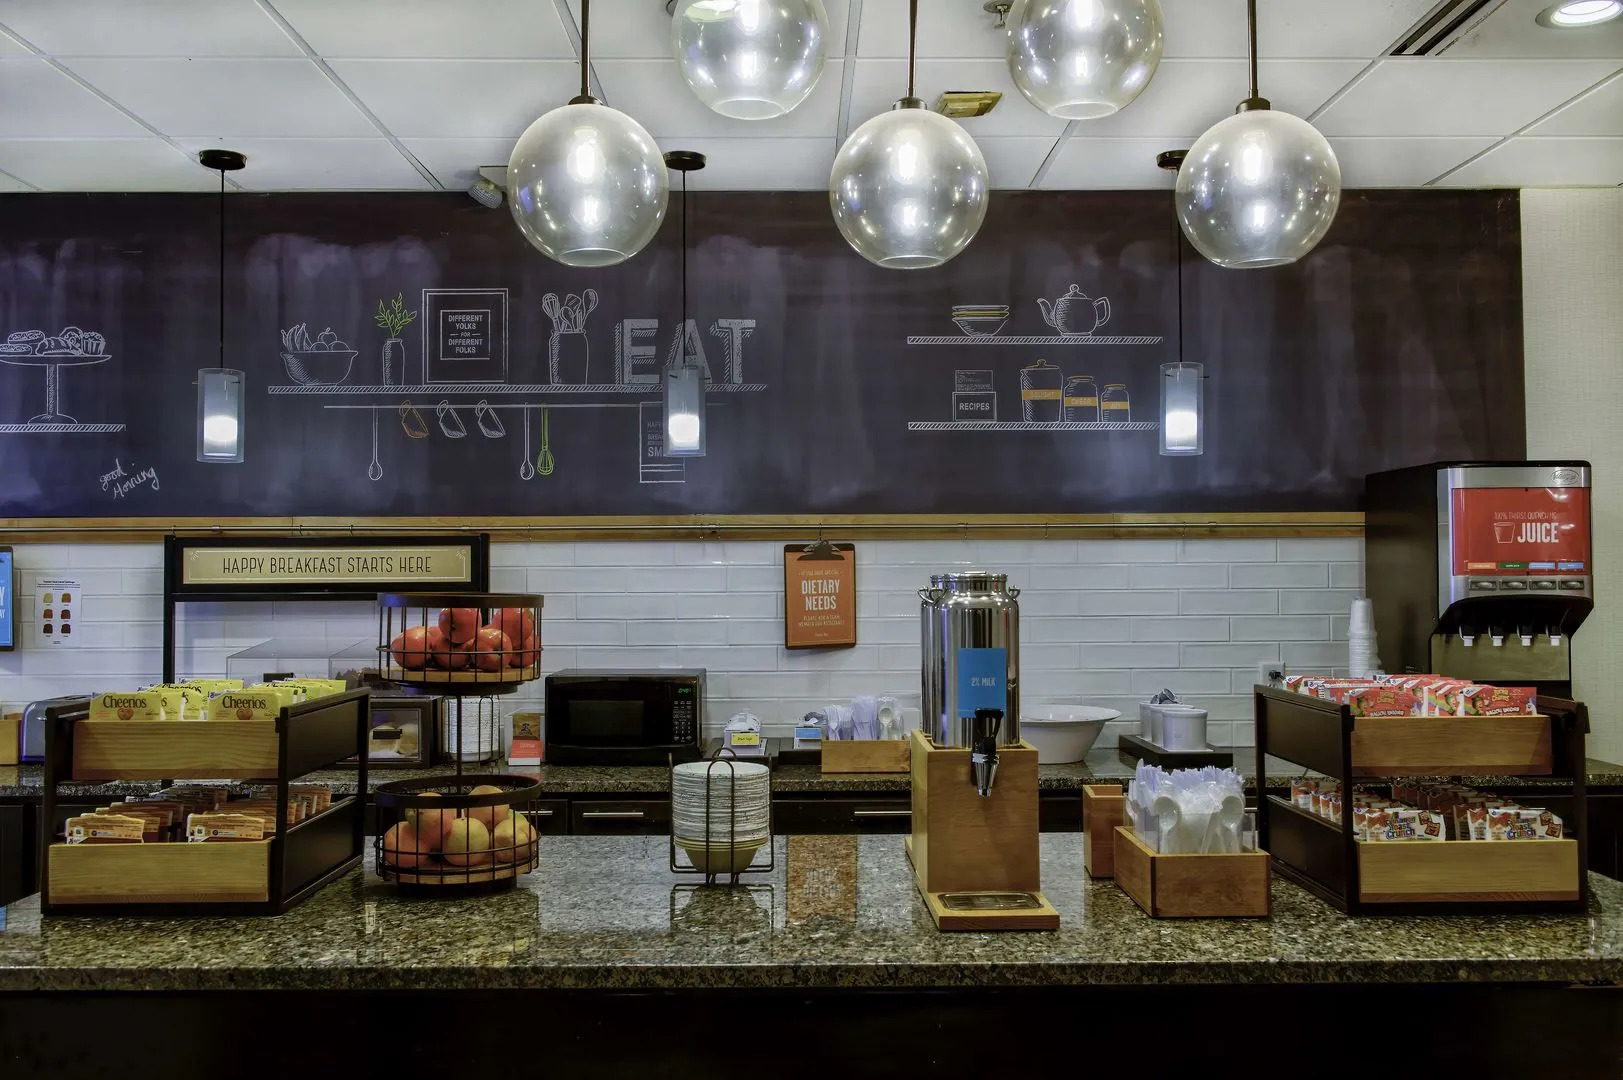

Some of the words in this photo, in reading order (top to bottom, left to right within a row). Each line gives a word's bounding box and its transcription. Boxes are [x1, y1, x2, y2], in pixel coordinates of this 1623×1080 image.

[448, 314, 484, 322] DIFFERENT
[448, 338, 484, 346] DIFFERENT
[455, 346, 477, 354] FOLKS
[615, 318, 756, 385] EAT
[959, 402, 990, 411] RECIPES
[1517, 522, 1560, 544] JUICE
[222, 557, 265, 575] HAPPY
[270, 556, 343, 574] BREAKFAST
[346, 556, 394, 573] STARTS
[399, 556, 433, 573] HERE
[801, 578, 841, 596] DIETARY
[805, 595, 837, 612] NEEDS
[981, 676, 996, 687] MILK
[102, 695, 148, 709] Cheerios
[221, 695, 267, 710] Cheerios
